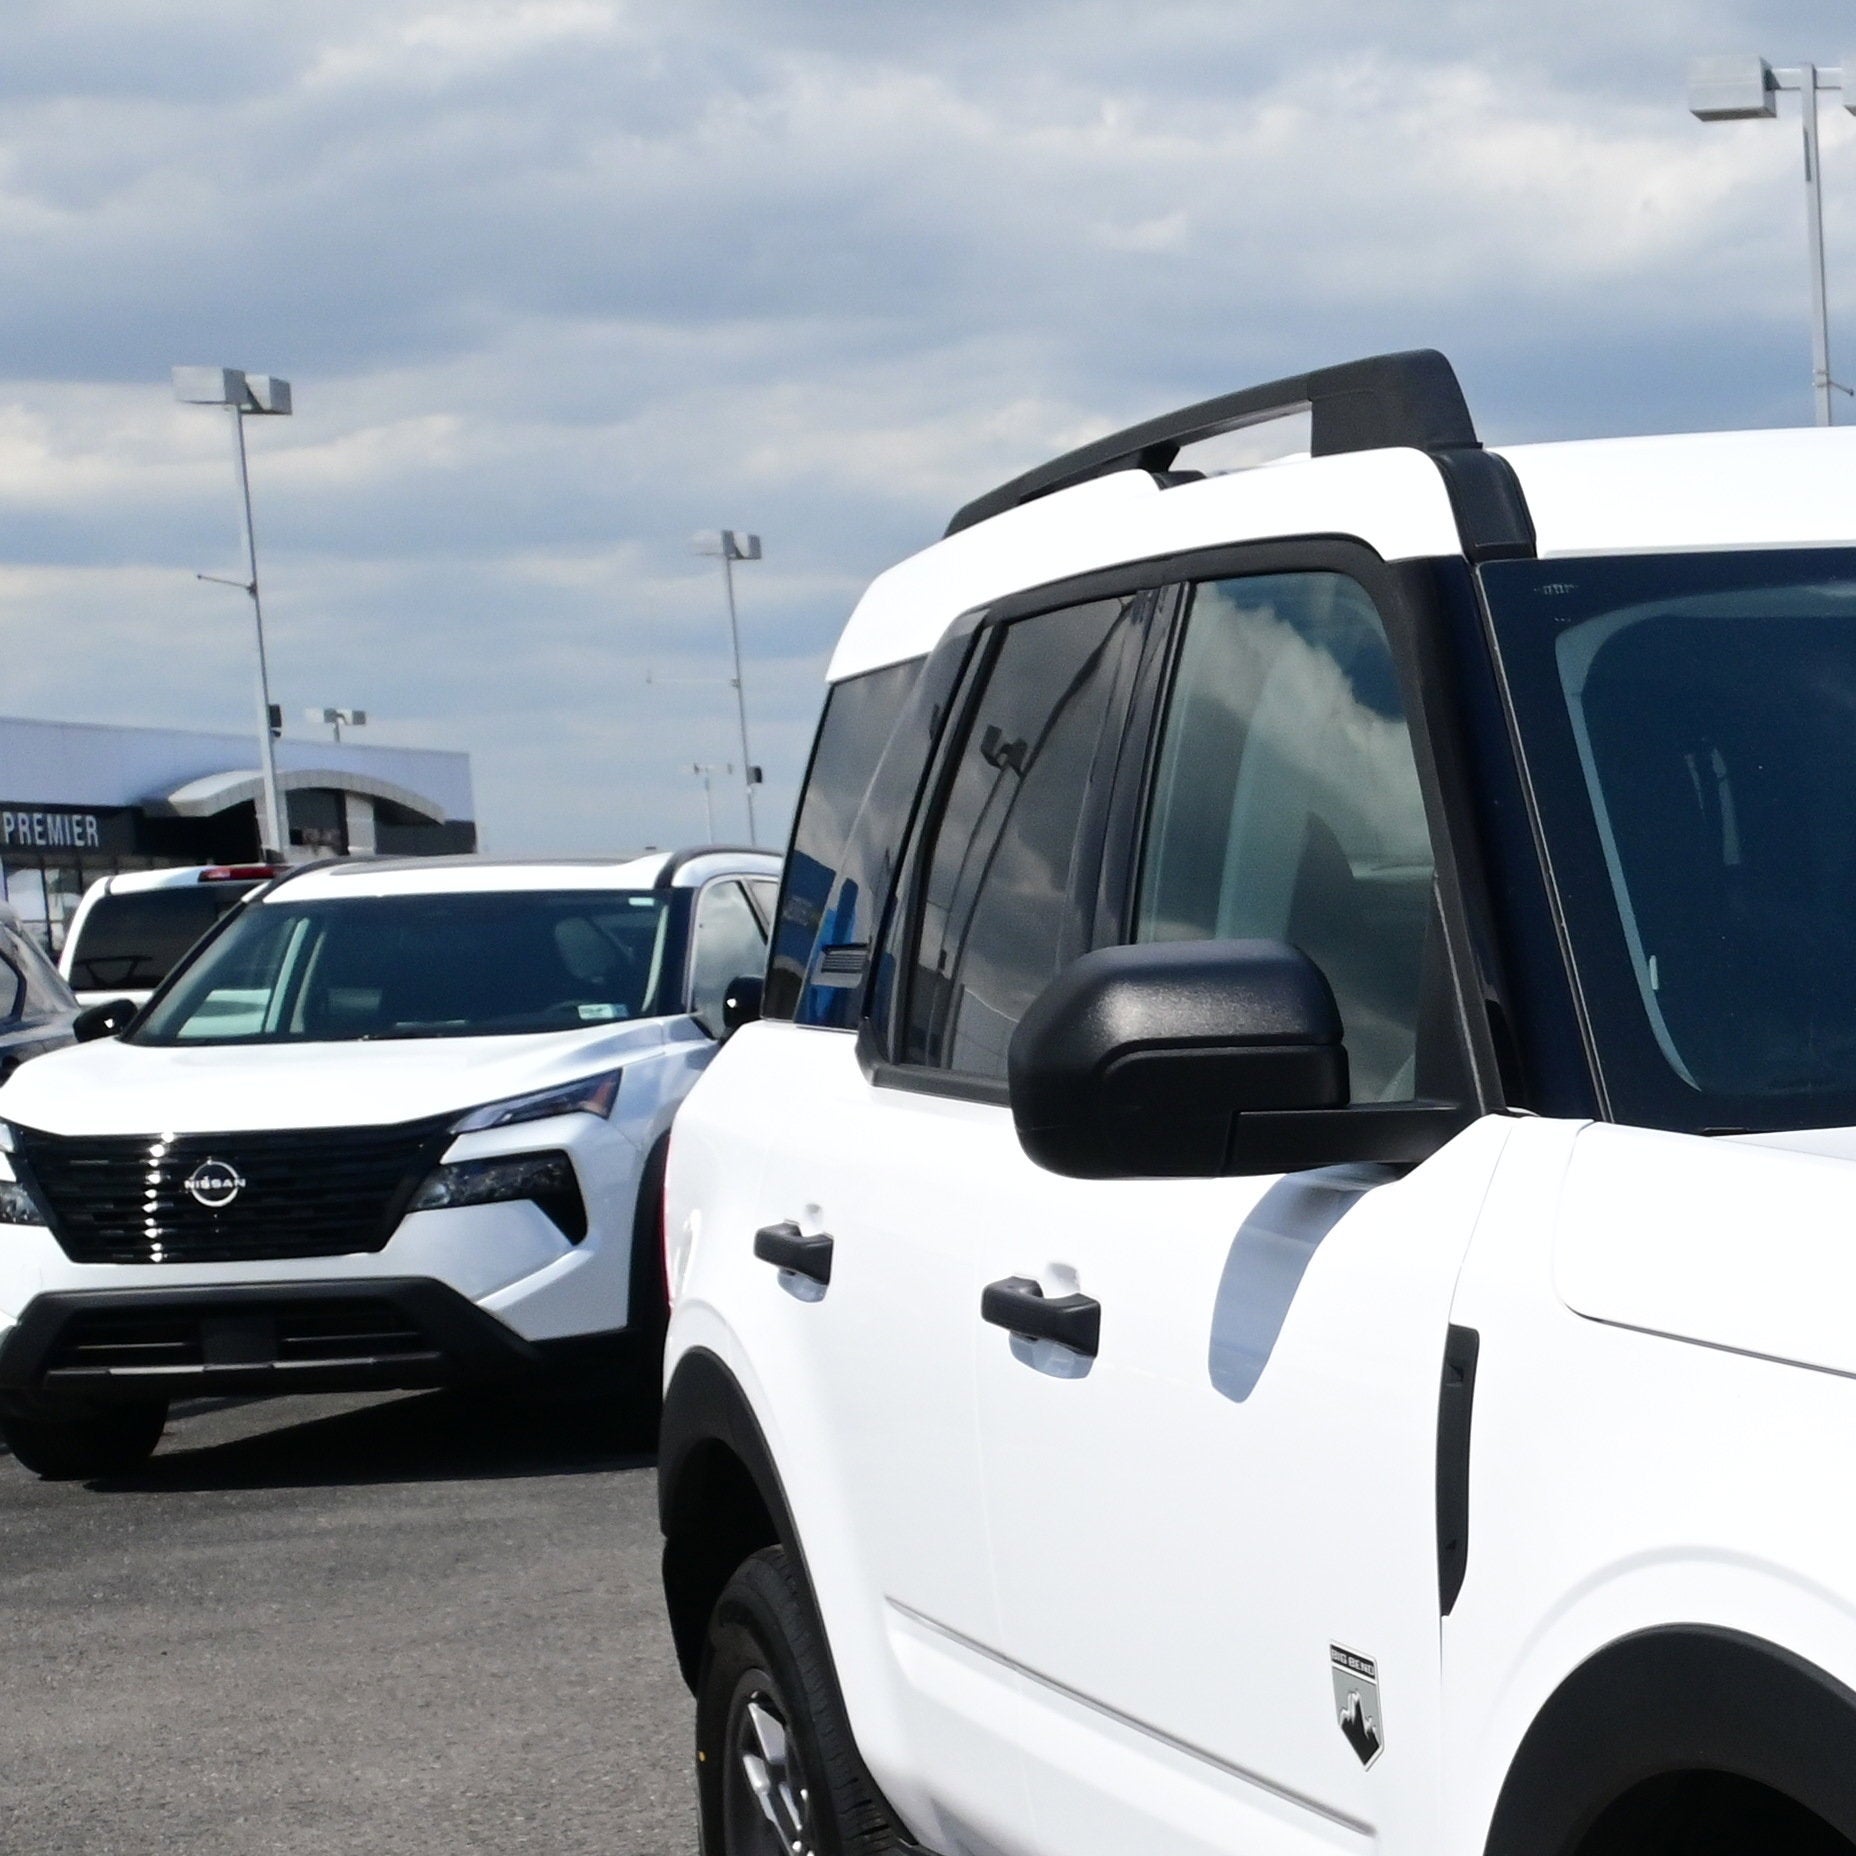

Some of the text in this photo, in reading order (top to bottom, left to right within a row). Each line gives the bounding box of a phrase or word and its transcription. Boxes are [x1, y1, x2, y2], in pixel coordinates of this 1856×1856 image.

[2, 811, 99, 848] PREMIER
[184, 1177, 247, 1190] NISSAN
[1331, 1648, 1376, 1677] BIG BEND
